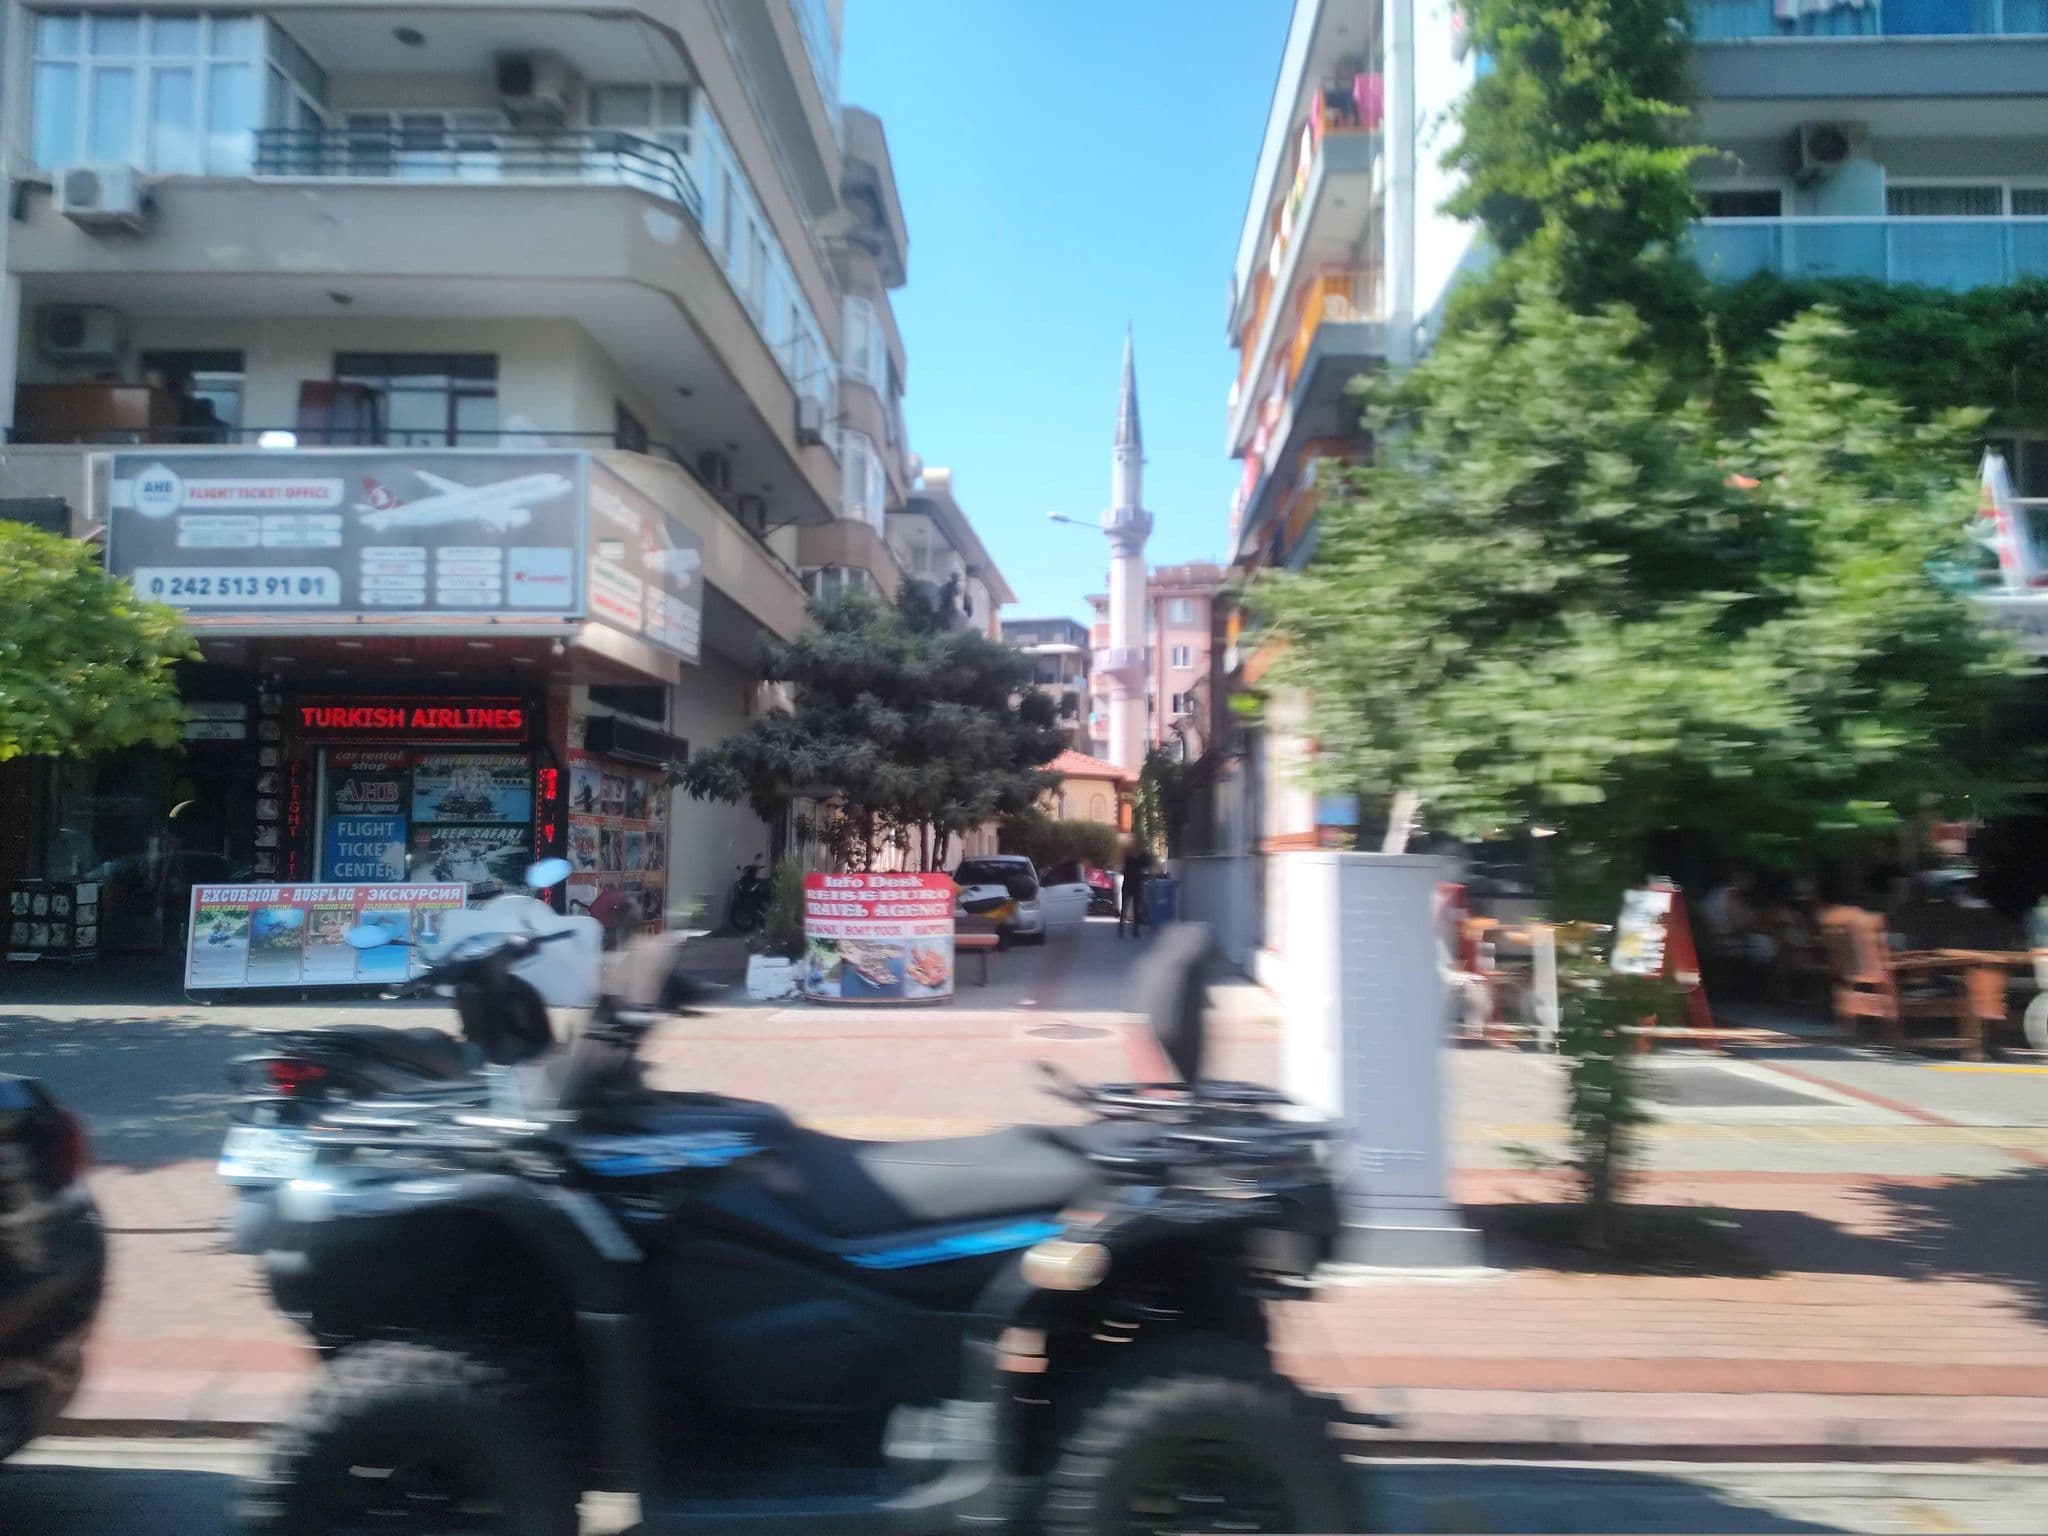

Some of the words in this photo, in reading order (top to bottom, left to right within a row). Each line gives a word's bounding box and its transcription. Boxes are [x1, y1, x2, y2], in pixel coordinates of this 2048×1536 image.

[151, 576, 164, 595] 0
[170, 576, 211, 596] 242
[218, 576, 258, 596] 513
[266, 576, 291, 595] 91
[298, 576, 324, 596] 01
[301, 707, 404, 728] TURKISH
[410, 708, 523, 728] AIRLINES
[336, 751, 358, 760] car
[360, 750, 404, 760] rental
[499, 757, 527, 767] TOUR
[352, 761, 386, 771] shop
[337, 822, 396, 836] FLIGHT
[432, 828, 467, 839] JEEP
[472, 828, 524, 840] SAFARI
[337, 842, 394, 857] TICKET
[334, 863, 395, 878] CENTER
[201, 888, 281, 903] EXCURSION
[292, 888, 356, 902] AUSFLUG
[367, 888, 461, 901] ЭКСКУРСИЯ
